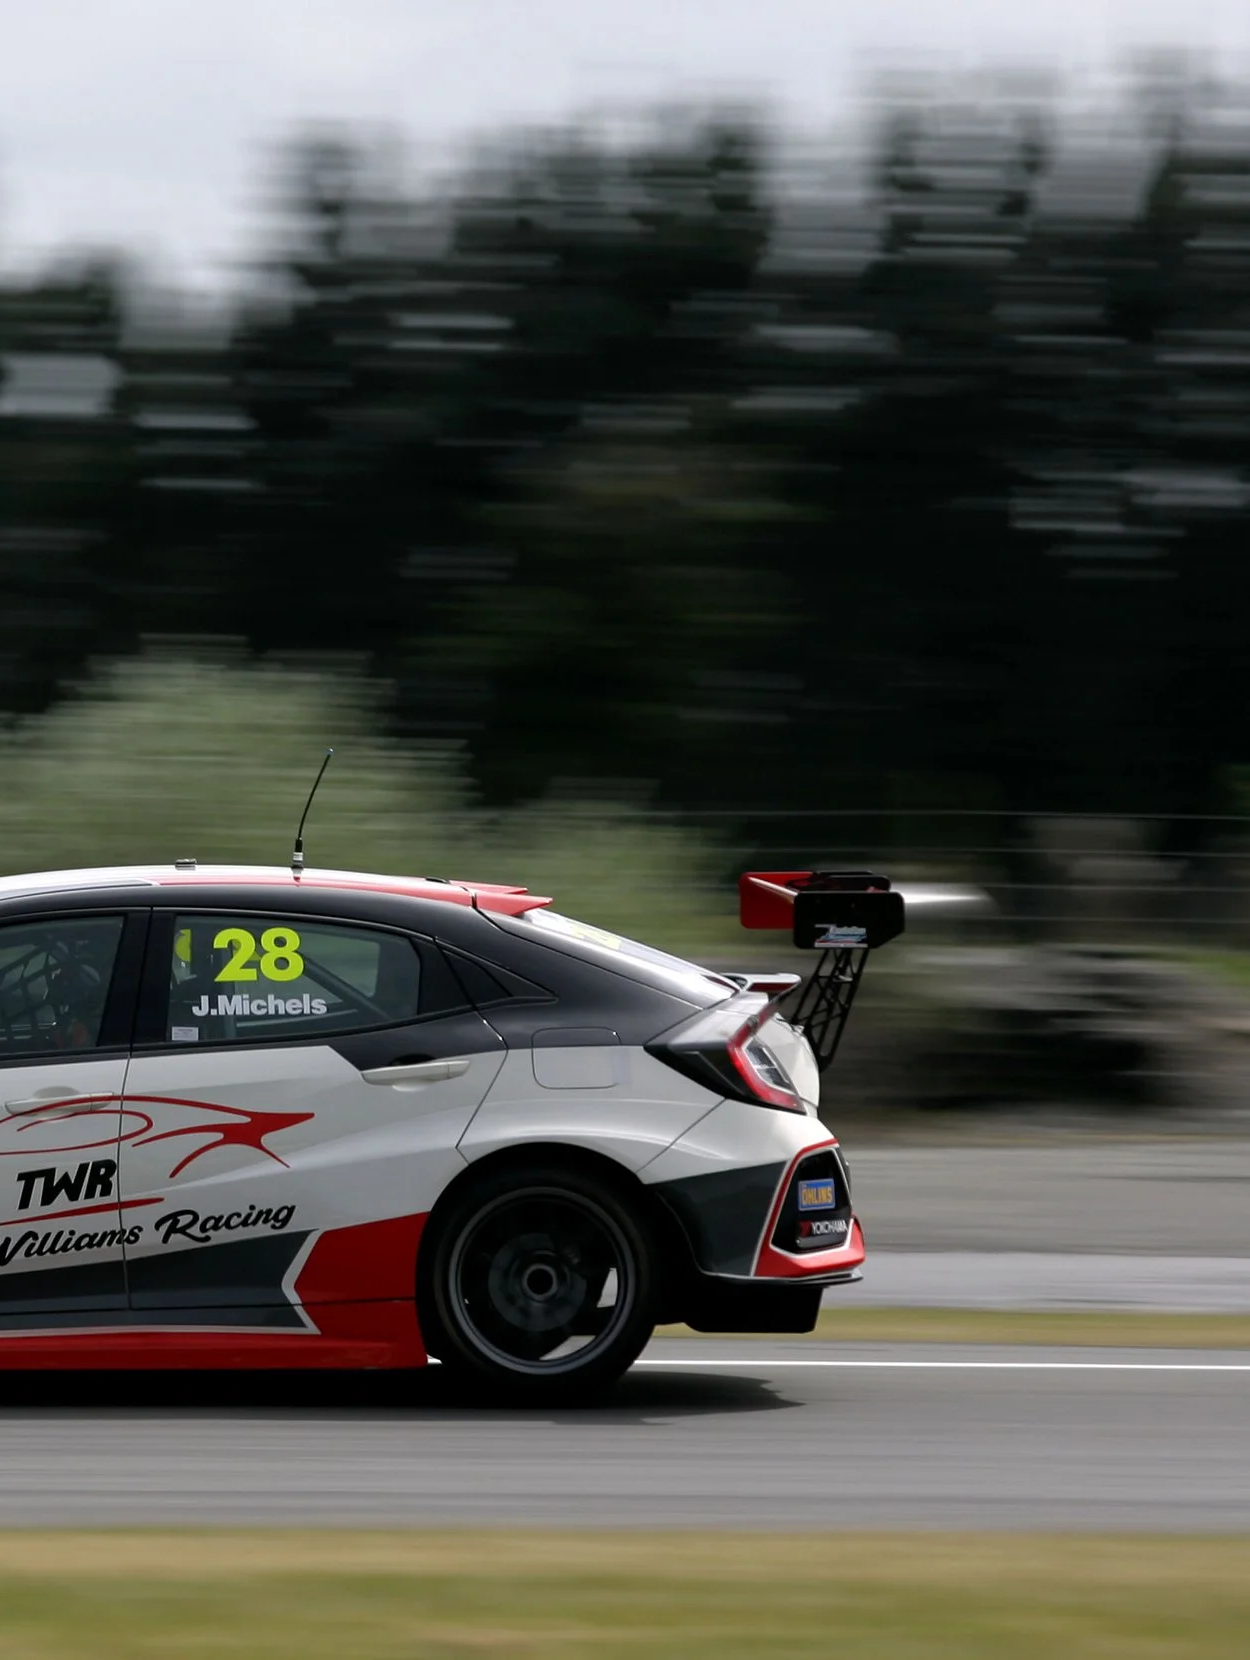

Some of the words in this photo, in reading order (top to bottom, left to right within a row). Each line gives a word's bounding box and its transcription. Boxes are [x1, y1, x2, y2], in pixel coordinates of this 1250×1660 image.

[213, 927, 304, 982] 28
[192, 993, 327, 1016] J.Michels
[16, 1159, 117, 1210] TWR
[154, 1204, 297, 1245] Racing
